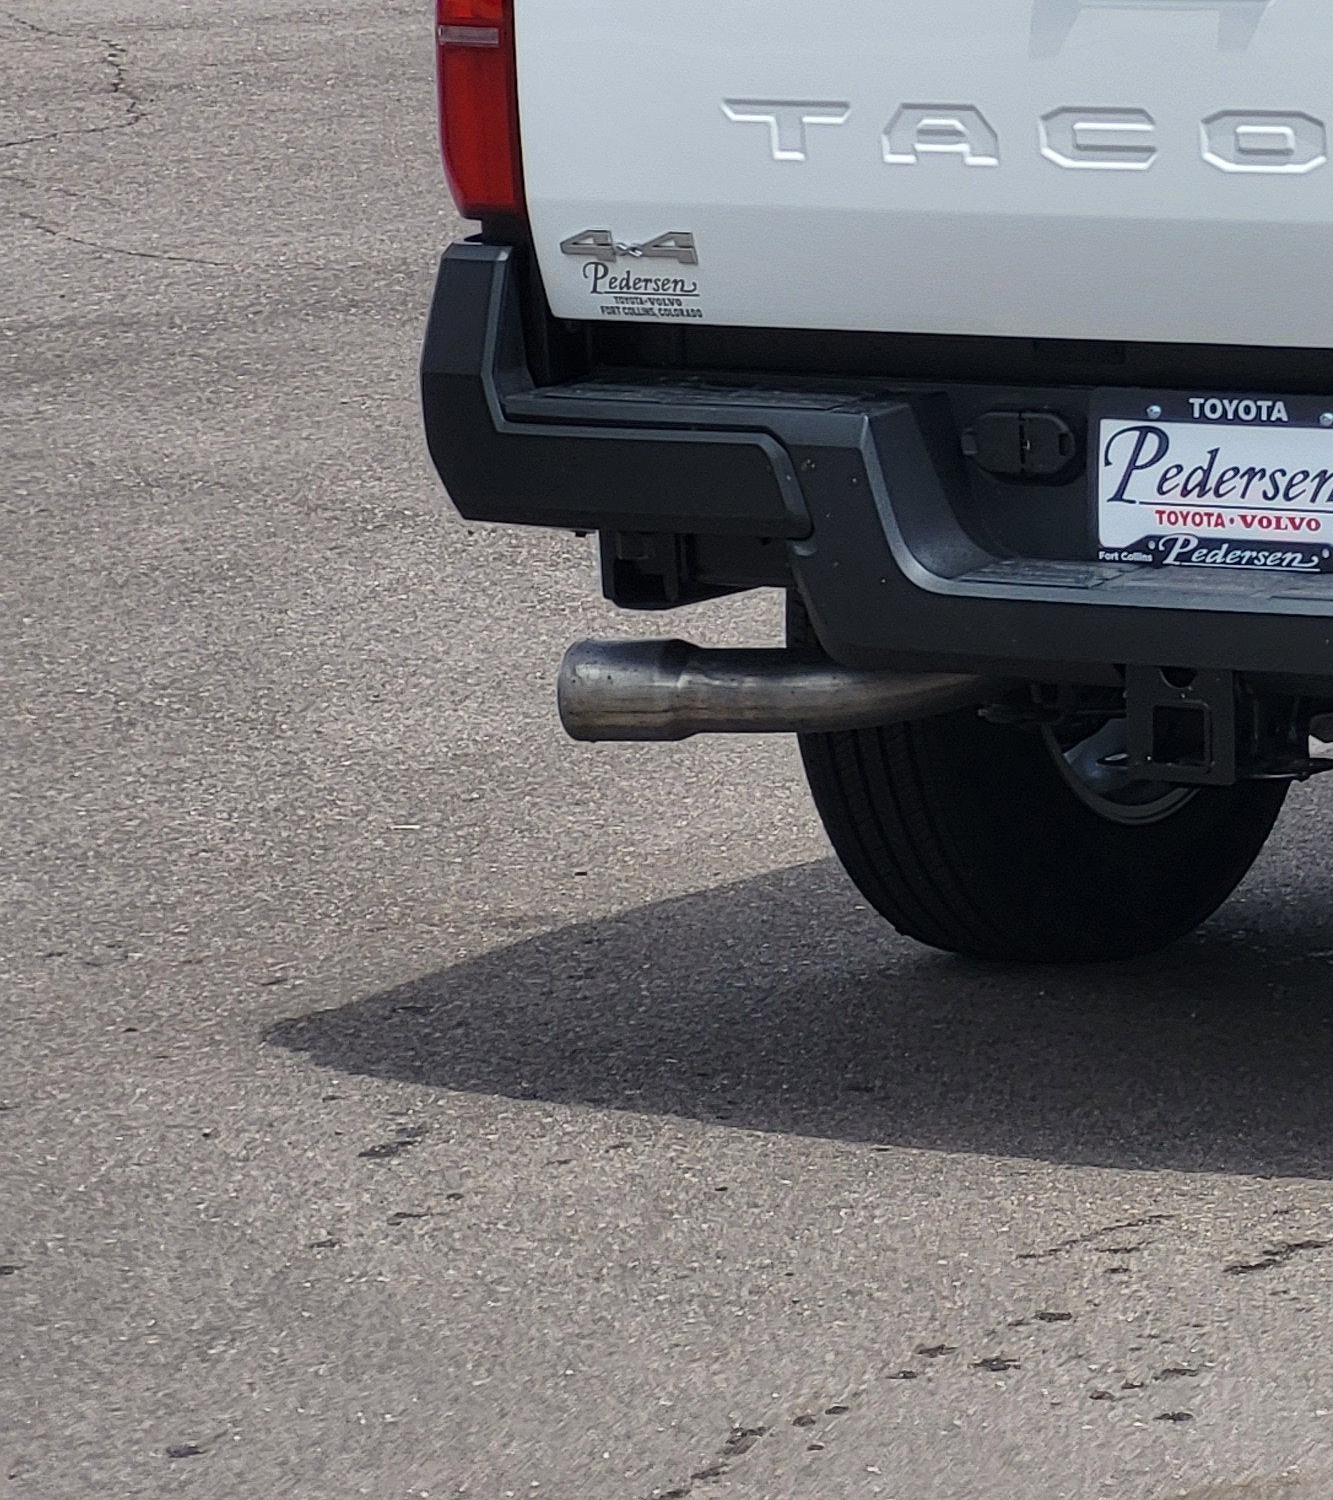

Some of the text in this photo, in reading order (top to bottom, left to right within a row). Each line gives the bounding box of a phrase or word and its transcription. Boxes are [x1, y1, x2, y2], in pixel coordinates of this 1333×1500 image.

[582, 261, 697, 294] Pedersen
[1188, 397, 1289, 422] TOYOTA
[1155, 509, 1321, 531] TOYOTA VOLVO
[1099, 551, 1152, 562] Fort Collins
[1159, 533, 1319, 566] Pedersen
